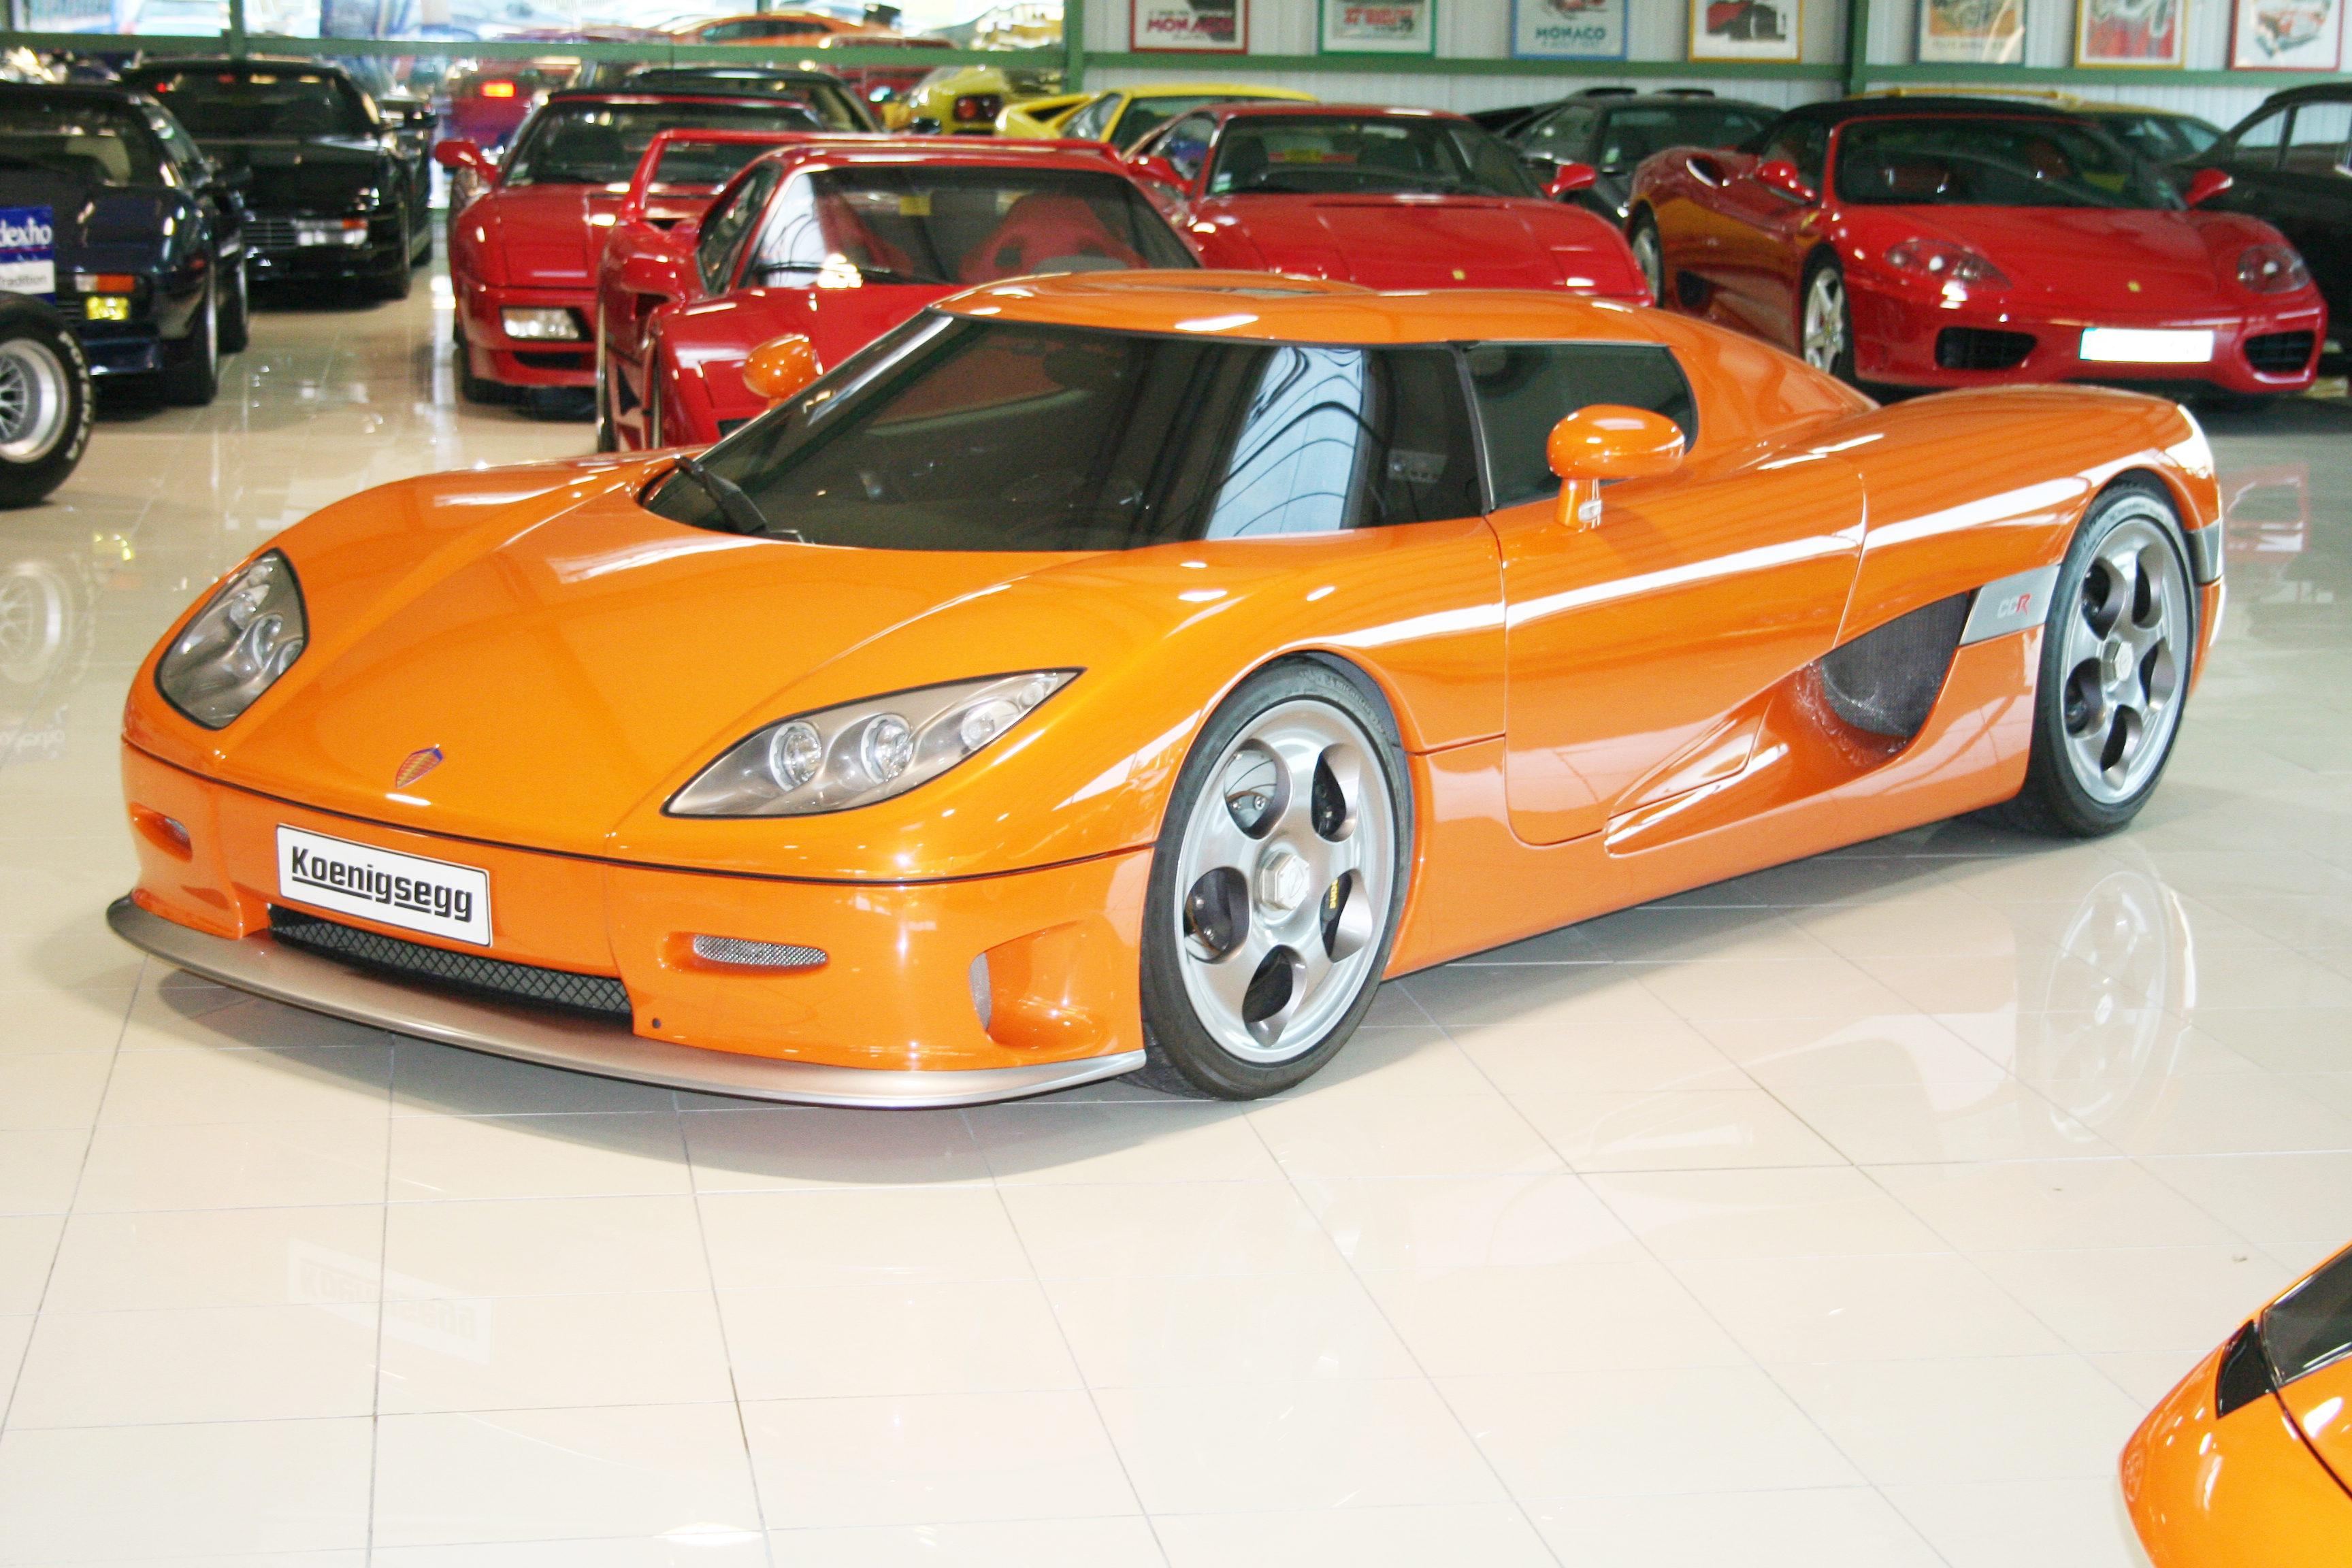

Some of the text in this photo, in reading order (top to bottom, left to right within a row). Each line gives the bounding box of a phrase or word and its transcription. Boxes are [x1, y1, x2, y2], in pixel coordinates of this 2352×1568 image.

[1147, 18, 1235, 33] MONACO
[1535, 26, 1607, 40] MONACO
[1997, 593, 2032, 619] CCR
[292, 846, 473, 923] Koenigsegg
